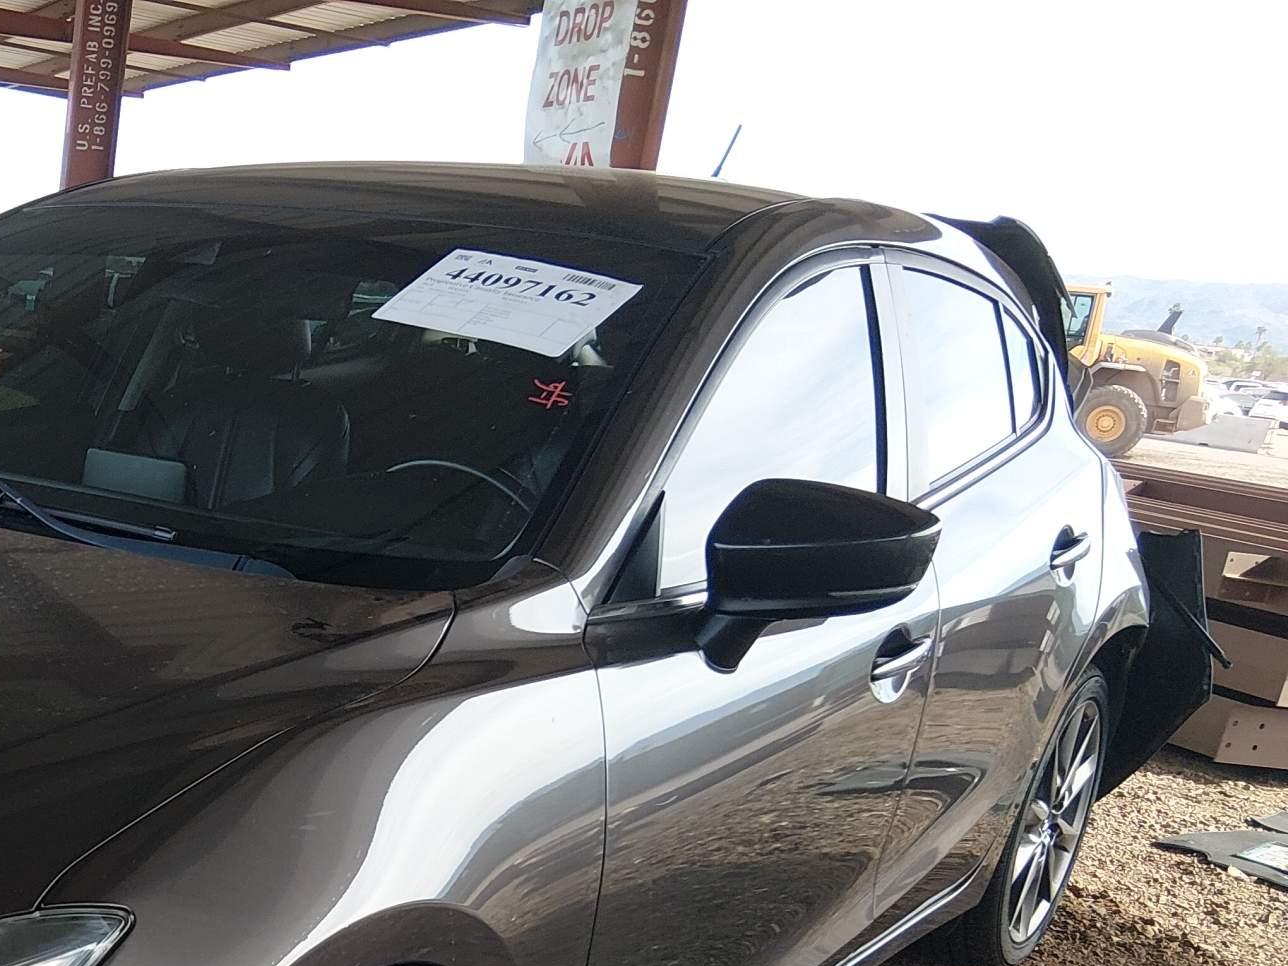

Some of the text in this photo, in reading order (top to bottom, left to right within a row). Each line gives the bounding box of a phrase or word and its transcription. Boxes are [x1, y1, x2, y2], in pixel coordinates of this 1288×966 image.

[554, 1, 615, 47] DROP
[76, 0, 104, 151] U.S. PREFAB INC.
[542, 64, 601, 109] ZONE
[445, 267, 598, 307] 44097162
